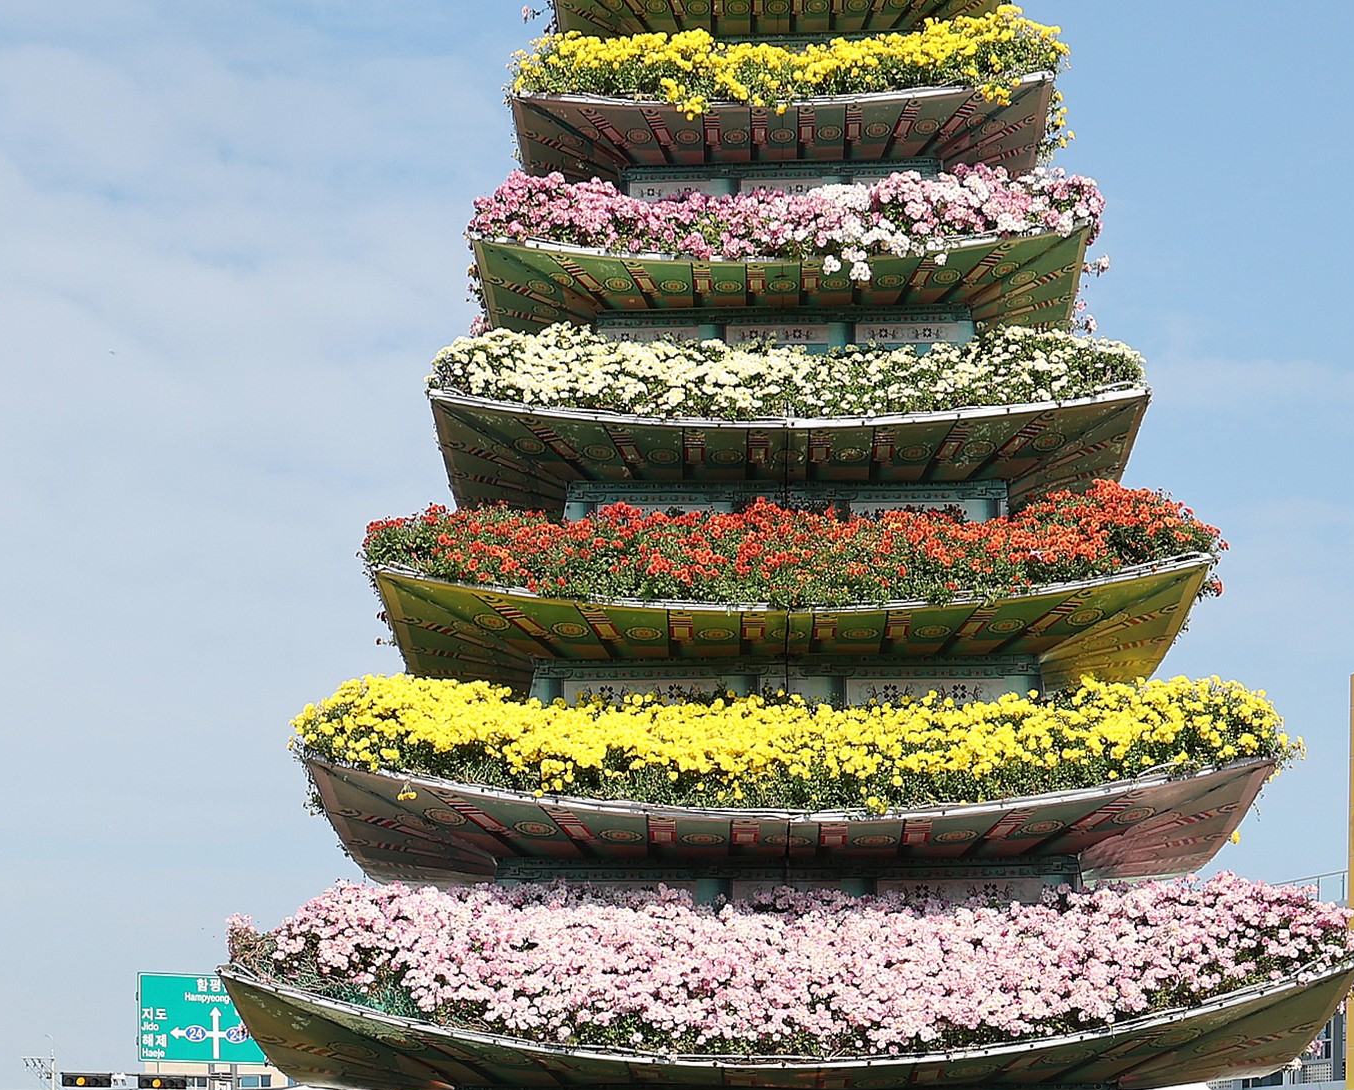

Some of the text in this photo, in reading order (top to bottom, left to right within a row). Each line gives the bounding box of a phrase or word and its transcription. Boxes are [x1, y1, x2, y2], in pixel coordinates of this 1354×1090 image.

[197, 977, 228, 993] 함평
[141, 1007, 167, 1021] 지도
[141, 1022, 159, 1031] Jido
[189, 1028, 203, 1040] 24
[229, 1030, 244, 1041] 24
[142, 1034, 167, 1048] 해제
